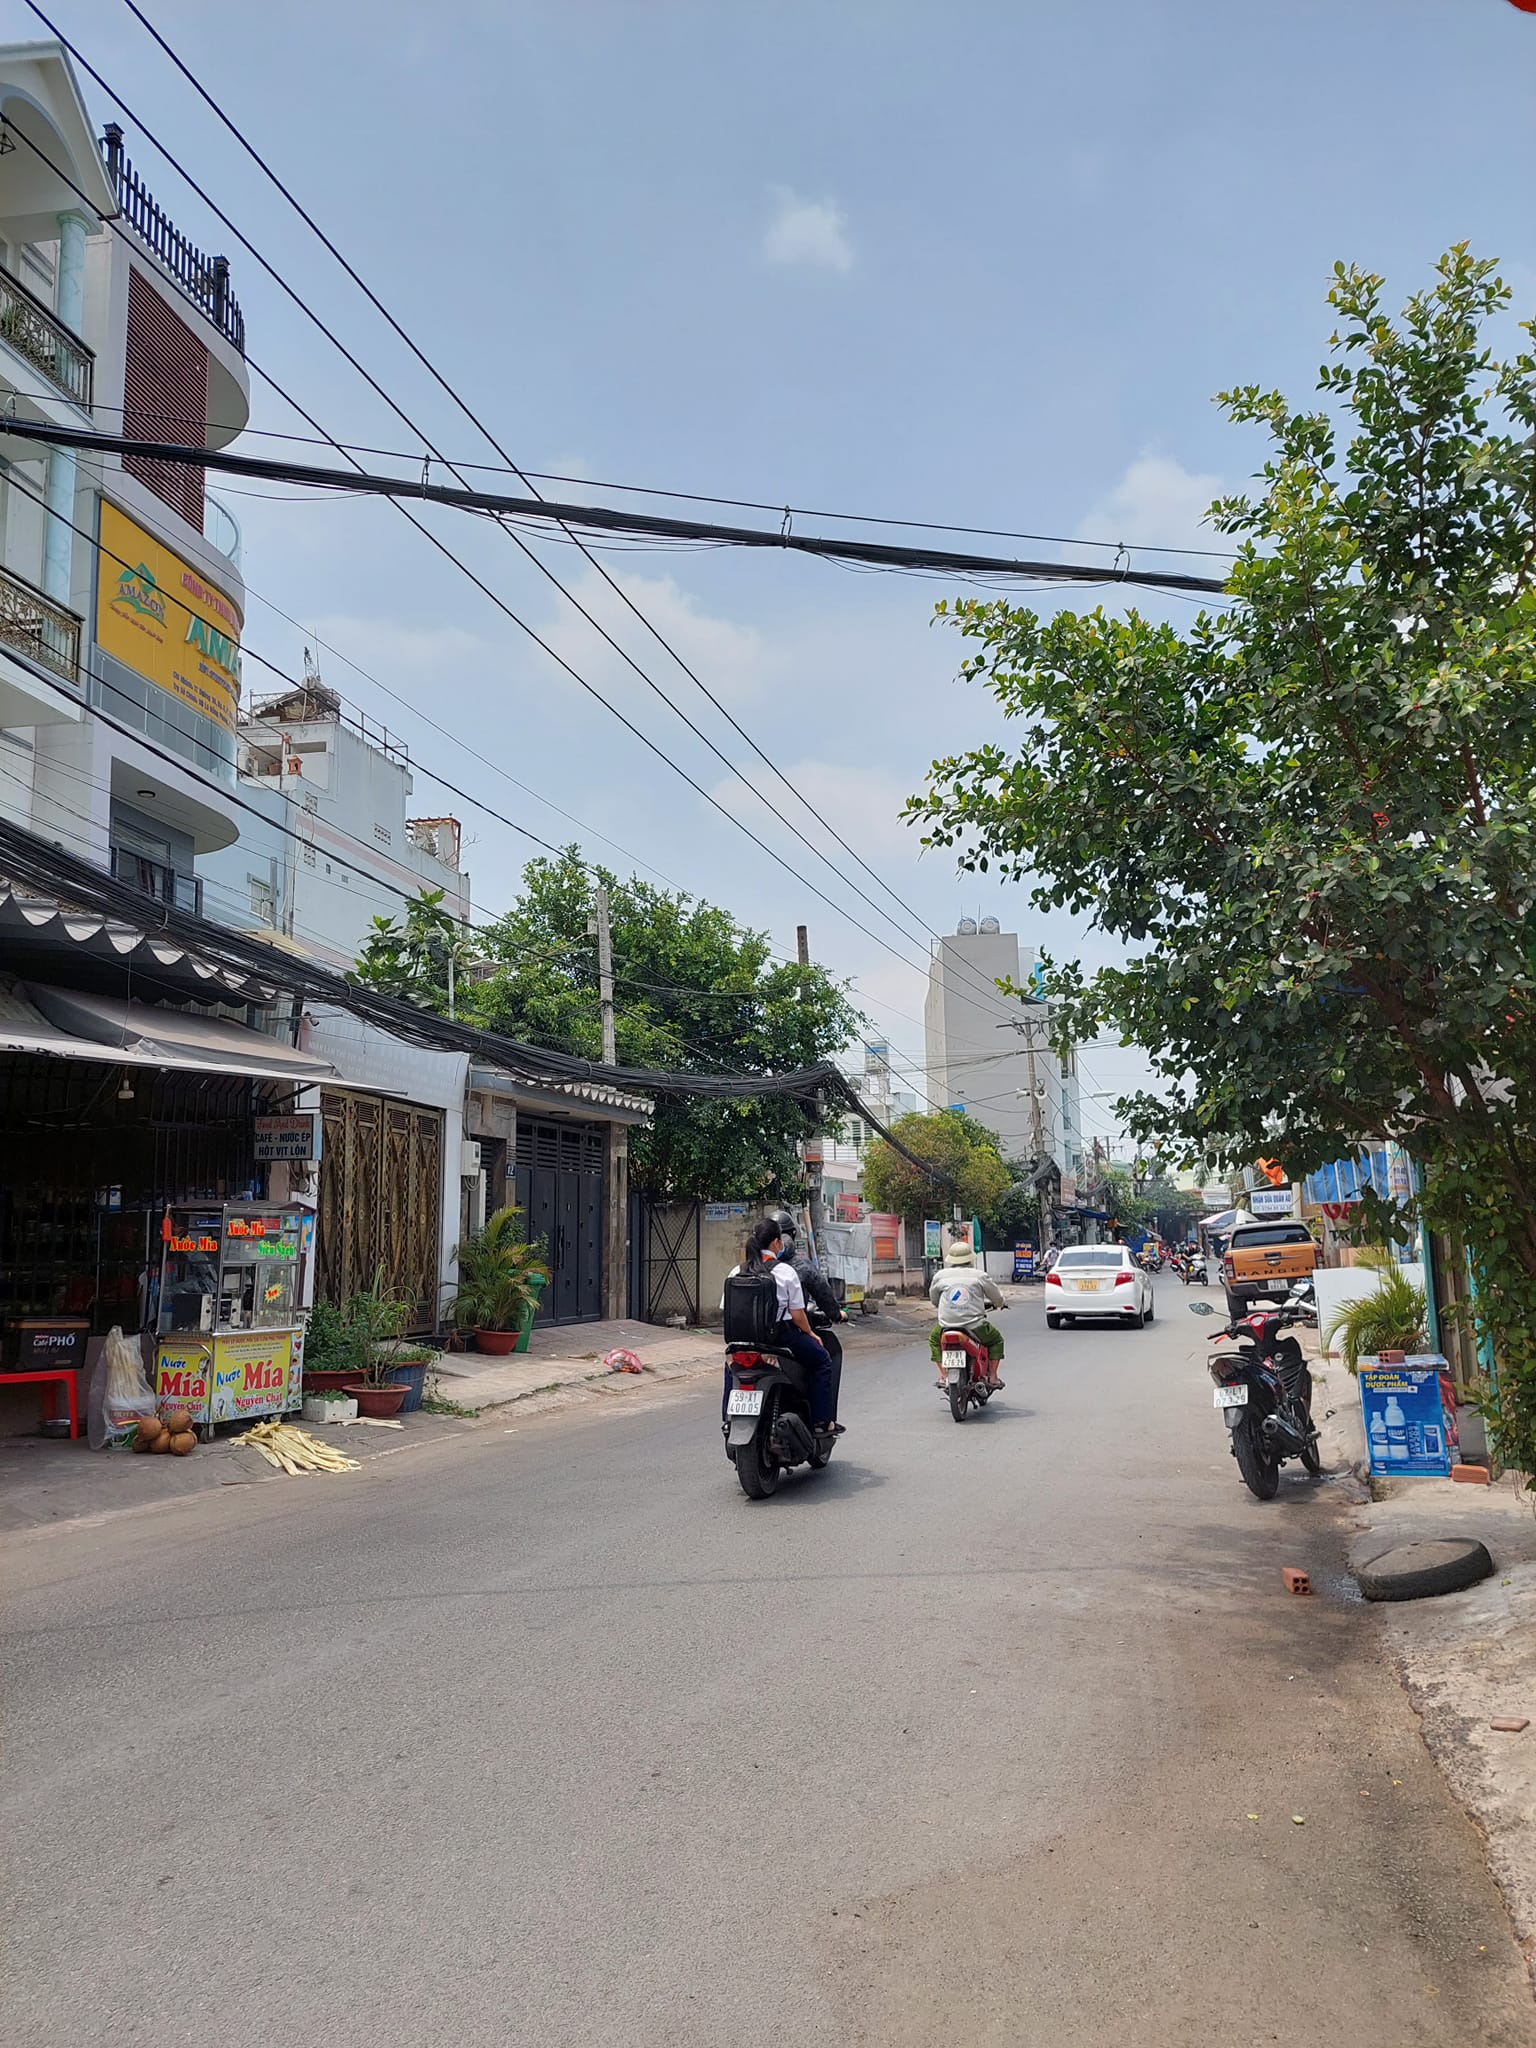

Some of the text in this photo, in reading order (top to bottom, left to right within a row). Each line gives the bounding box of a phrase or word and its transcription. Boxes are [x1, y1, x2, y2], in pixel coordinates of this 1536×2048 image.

[1237, 1266, 1315, 1277] RANGER
[159, 1371, 206, 1397] Mía
[242, 1360, 283, 1391] Mía
